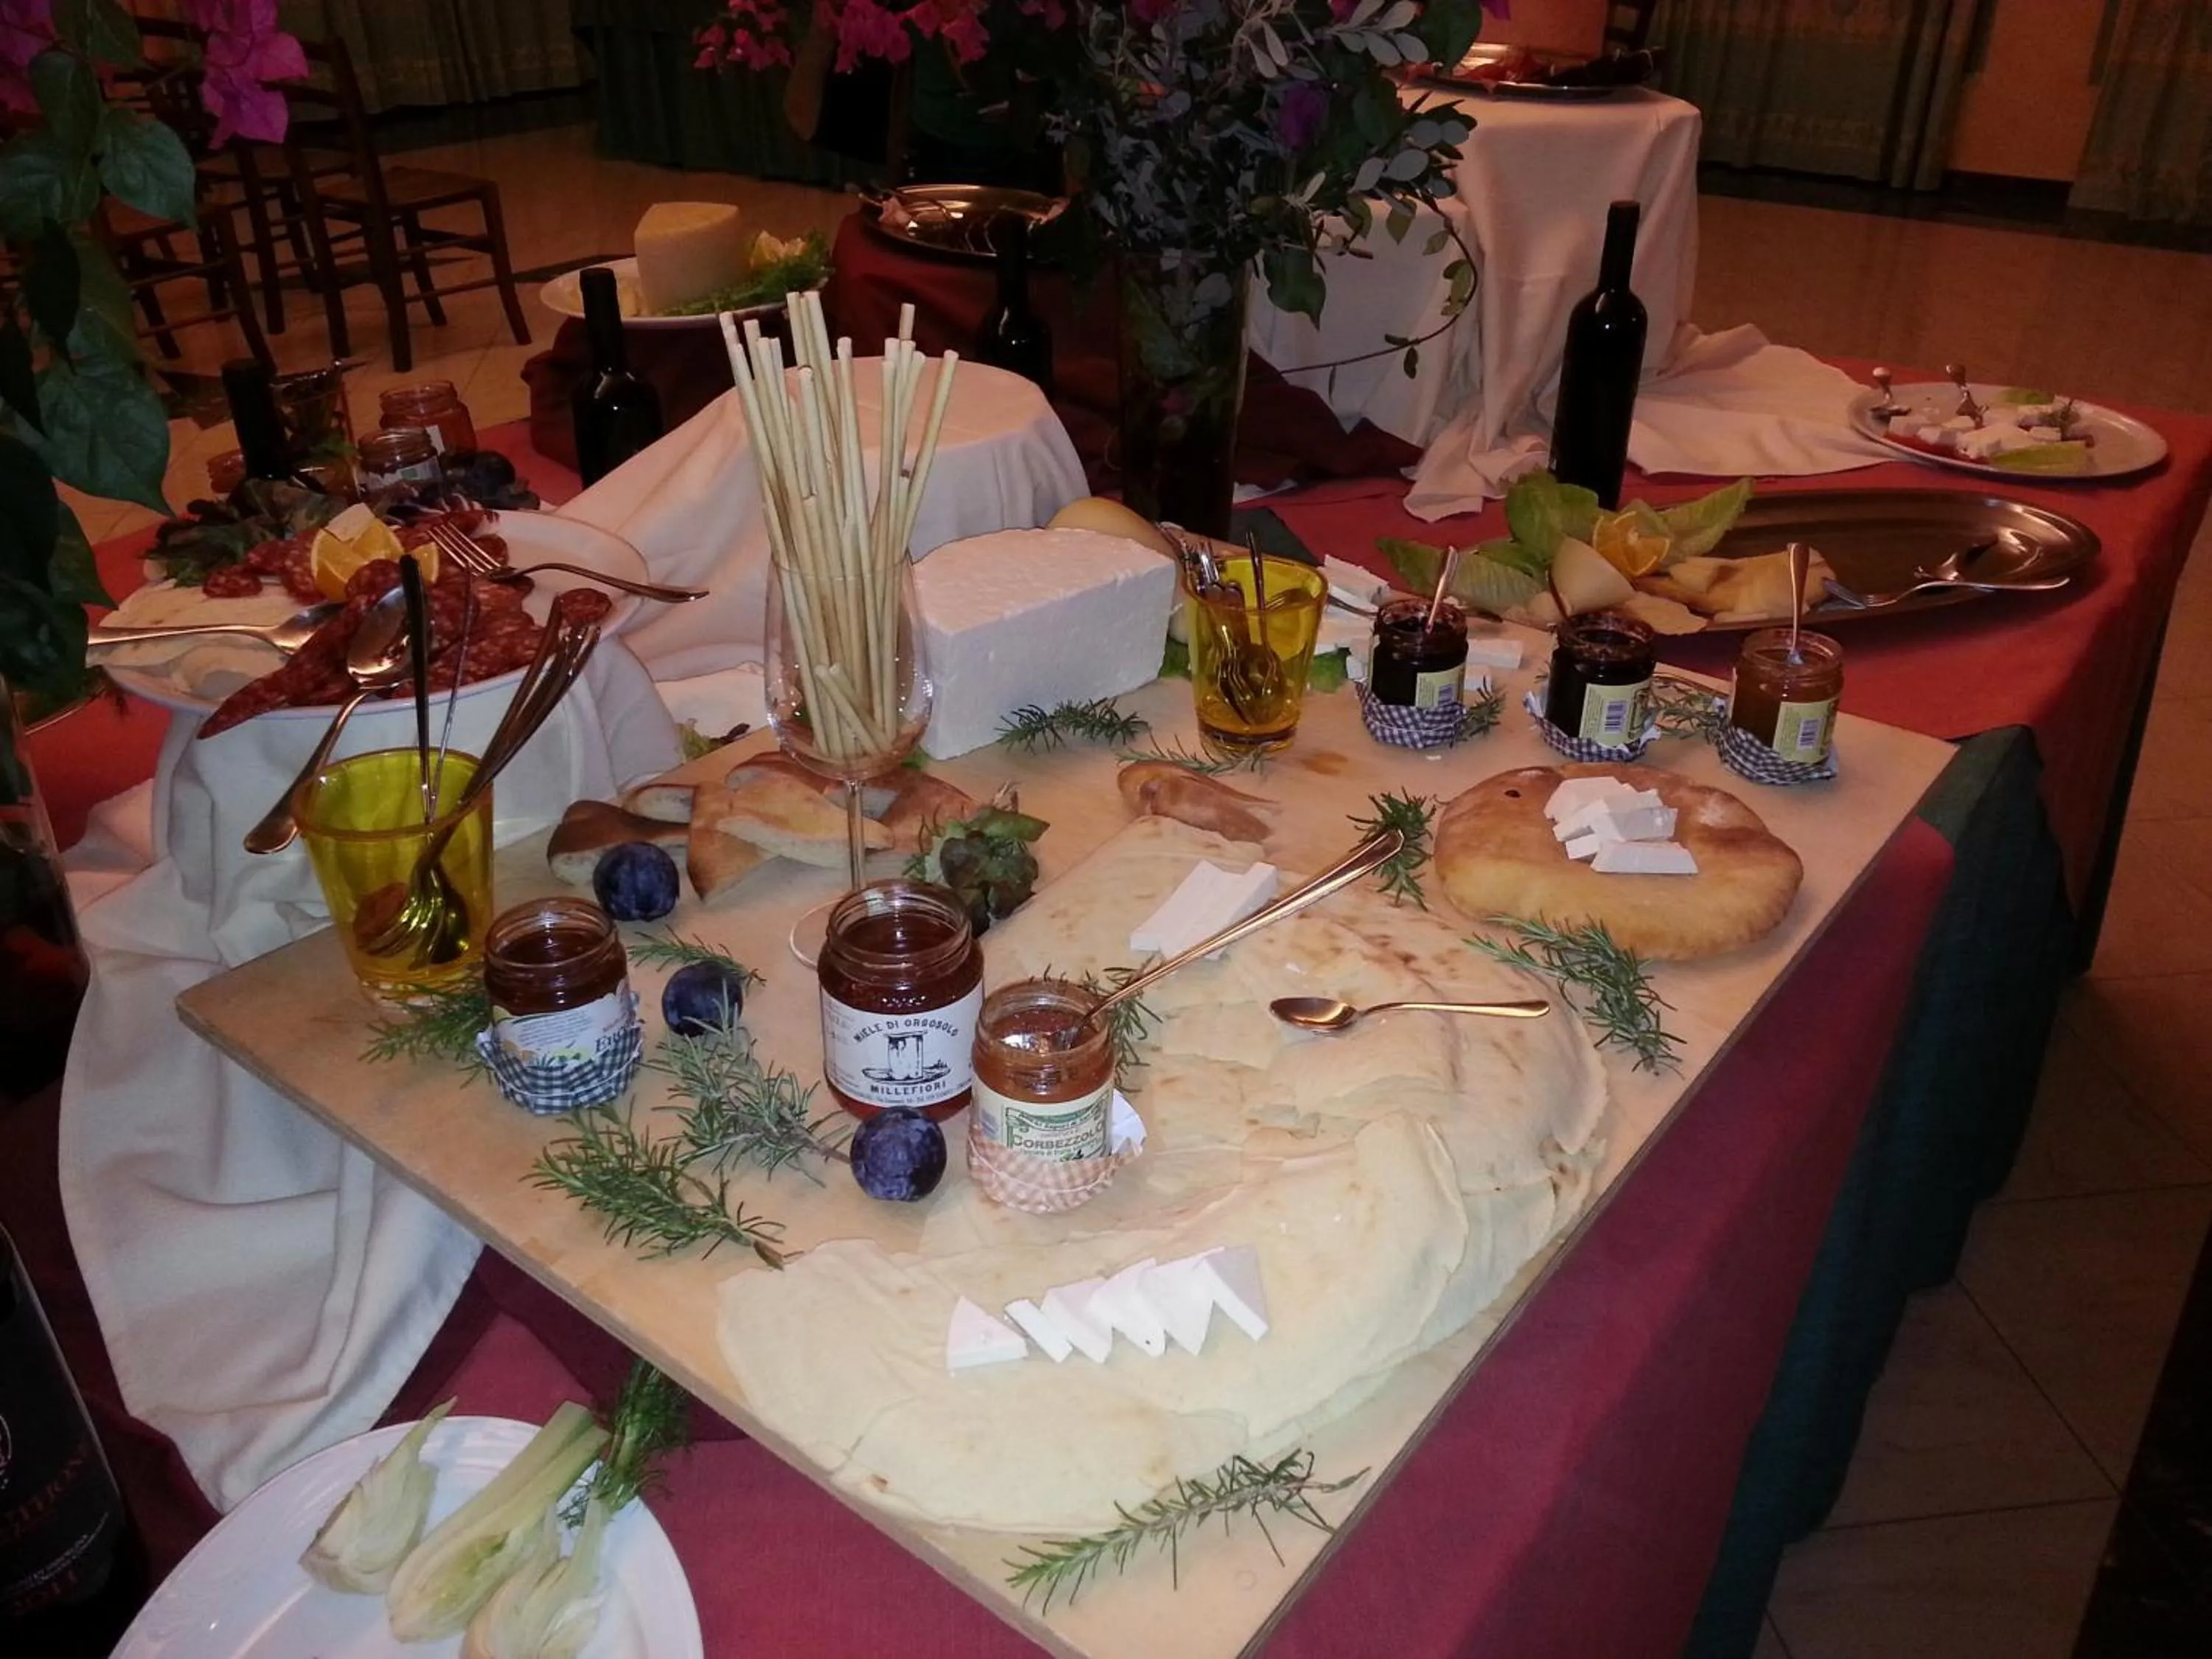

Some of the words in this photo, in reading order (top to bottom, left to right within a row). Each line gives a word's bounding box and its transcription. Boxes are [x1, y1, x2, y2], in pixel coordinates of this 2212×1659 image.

[853, 1023, 883, 1043] MIELE
[886, 1020, 899, 1030] DI
[870, 1080, 946, 1096] MILLEFIORI
[1012, 1119, 1104, 1150] CORBEZZOLO
